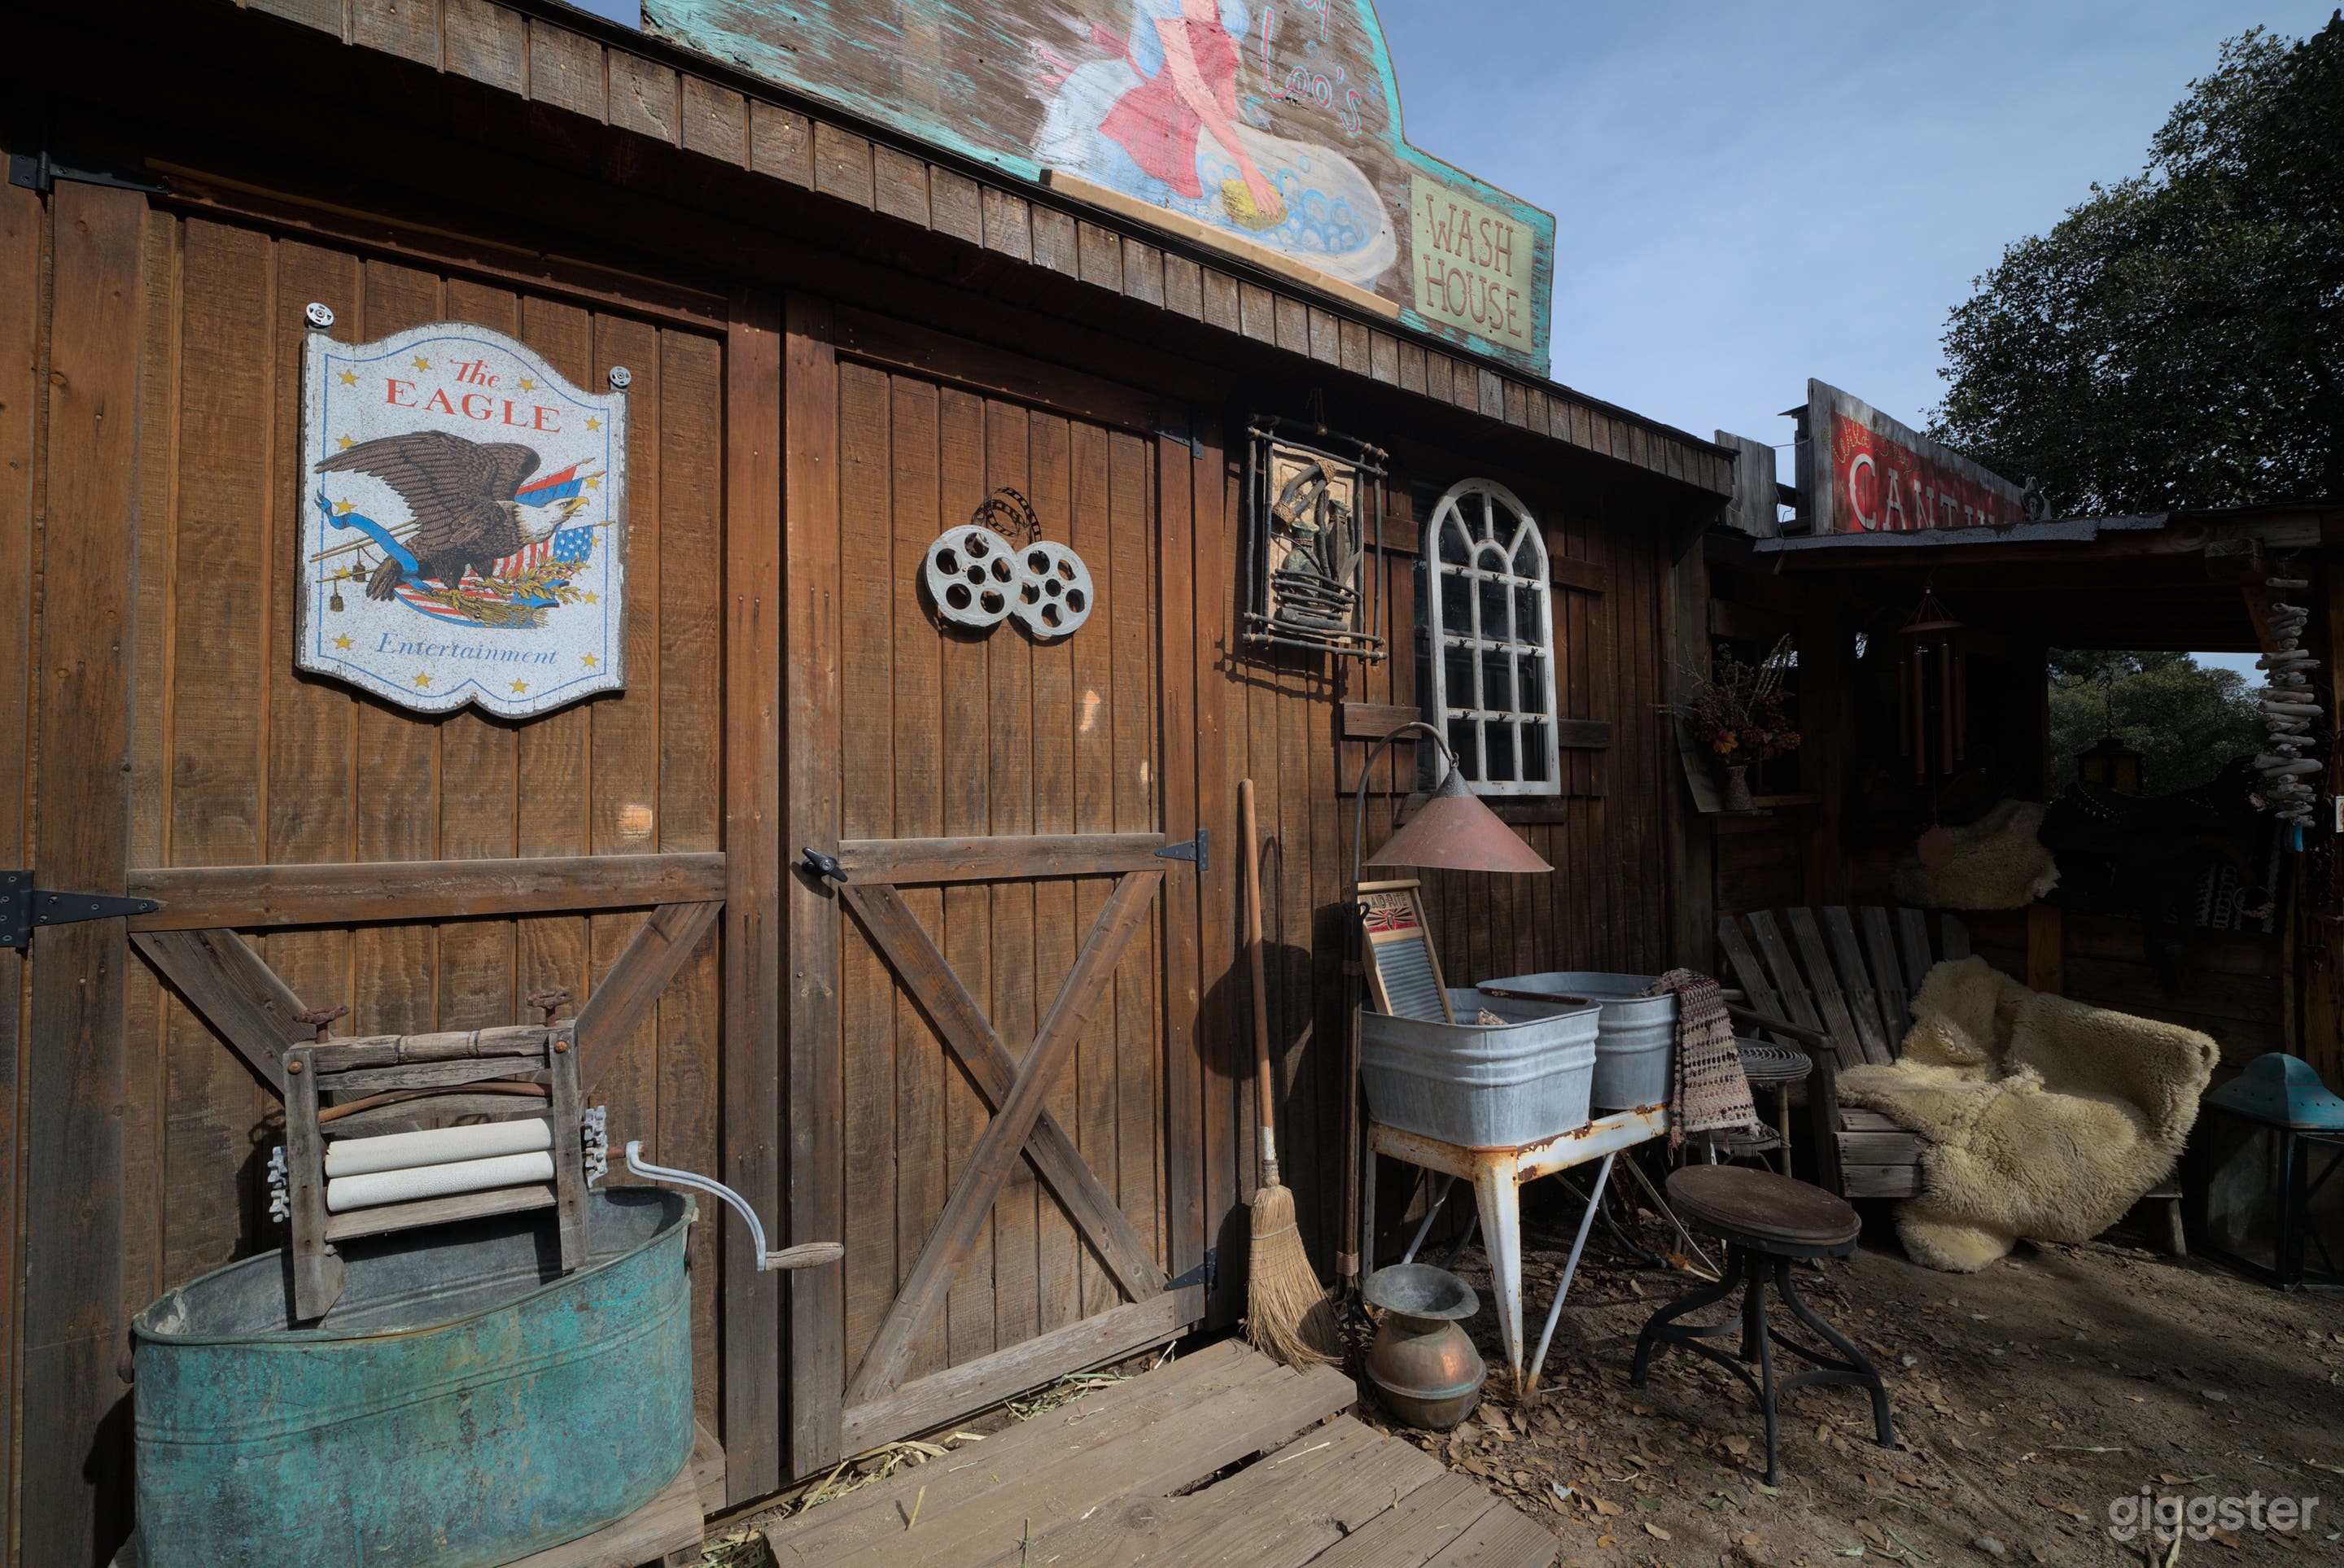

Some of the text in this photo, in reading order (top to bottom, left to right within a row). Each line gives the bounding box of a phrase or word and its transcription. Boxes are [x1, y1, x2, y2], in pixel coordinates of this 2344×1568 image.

[1261, 6, 1362, 137] Loo's
[1425, 193, 1514, 277] WASH
[1423, 253, 1522, 338] HOUSE
[384, 377, 562, 434] EAGLE
[449, 359, 501, 388] The
[376, 631, 558, 665] Entertainment
